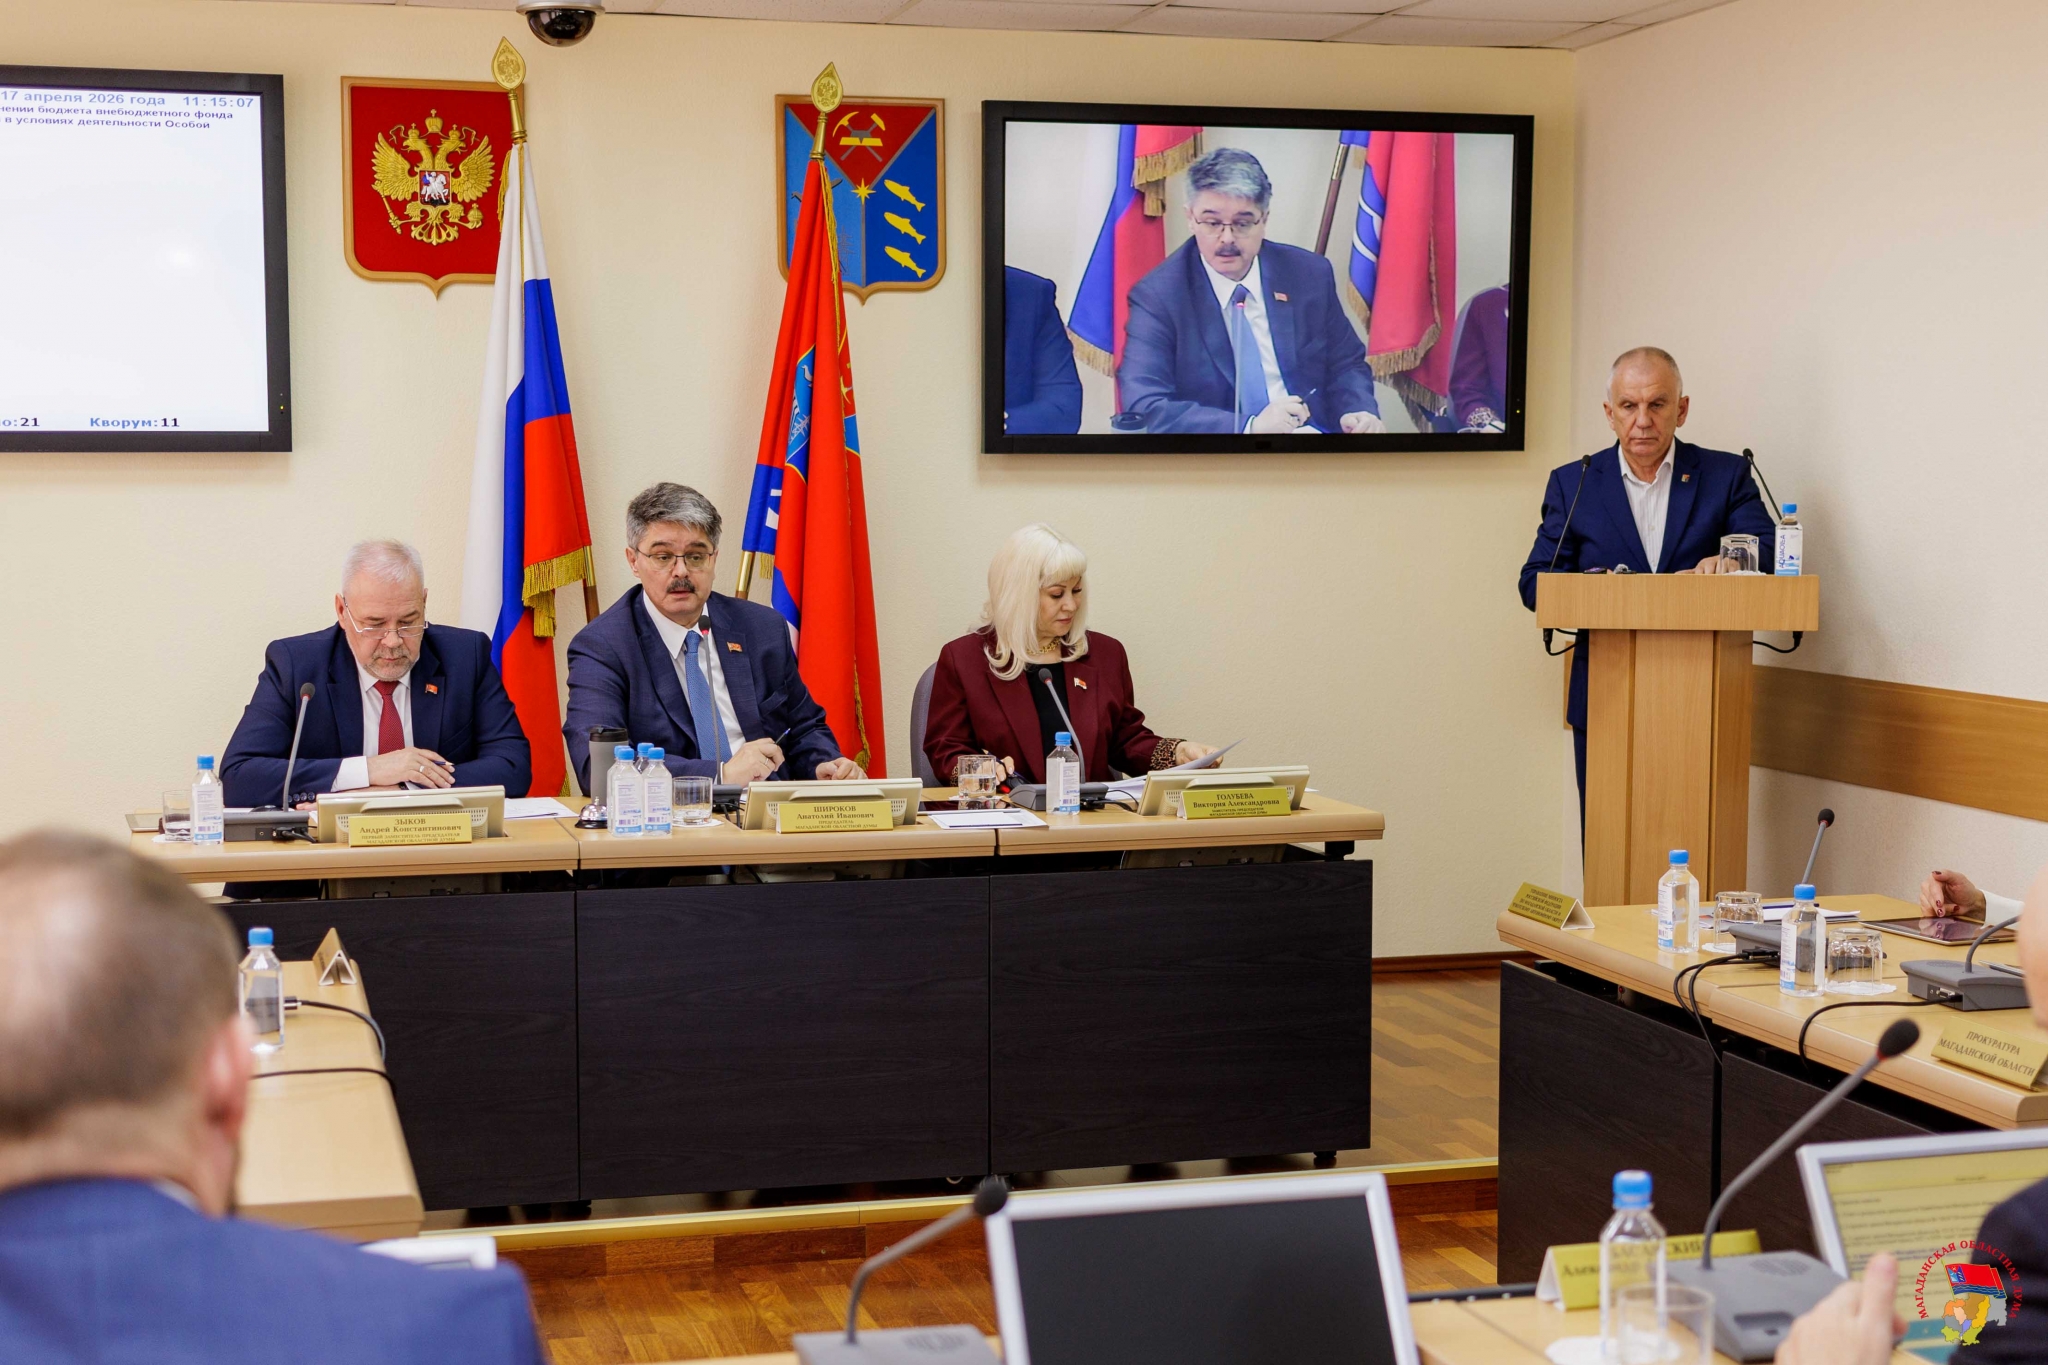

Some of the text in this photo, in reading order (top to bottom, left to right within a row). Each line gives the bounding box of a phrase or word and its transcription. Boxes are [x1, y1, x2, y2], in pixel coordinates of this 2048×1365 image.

[1, 91, 254, 108] 17 апреля 2026 года 11:15:07
[38, 105, 92, 115] бюджета
[96, 108, 190, 117] внебюджетного
[194, 110, 233, 119] фонда
[16, 117, 74, 125] условиях
[78, 119, 161, 127] деятельности
[165, 120, 210, 128] Особой
[393, 825, 461, 833] Константинович
[1966, 1031, 2020, 1055] ПРОКУРАТУРА
[1938, 1038, 2036, 1077] МАГАДАНСКОЙ ОБЛАСТИ
